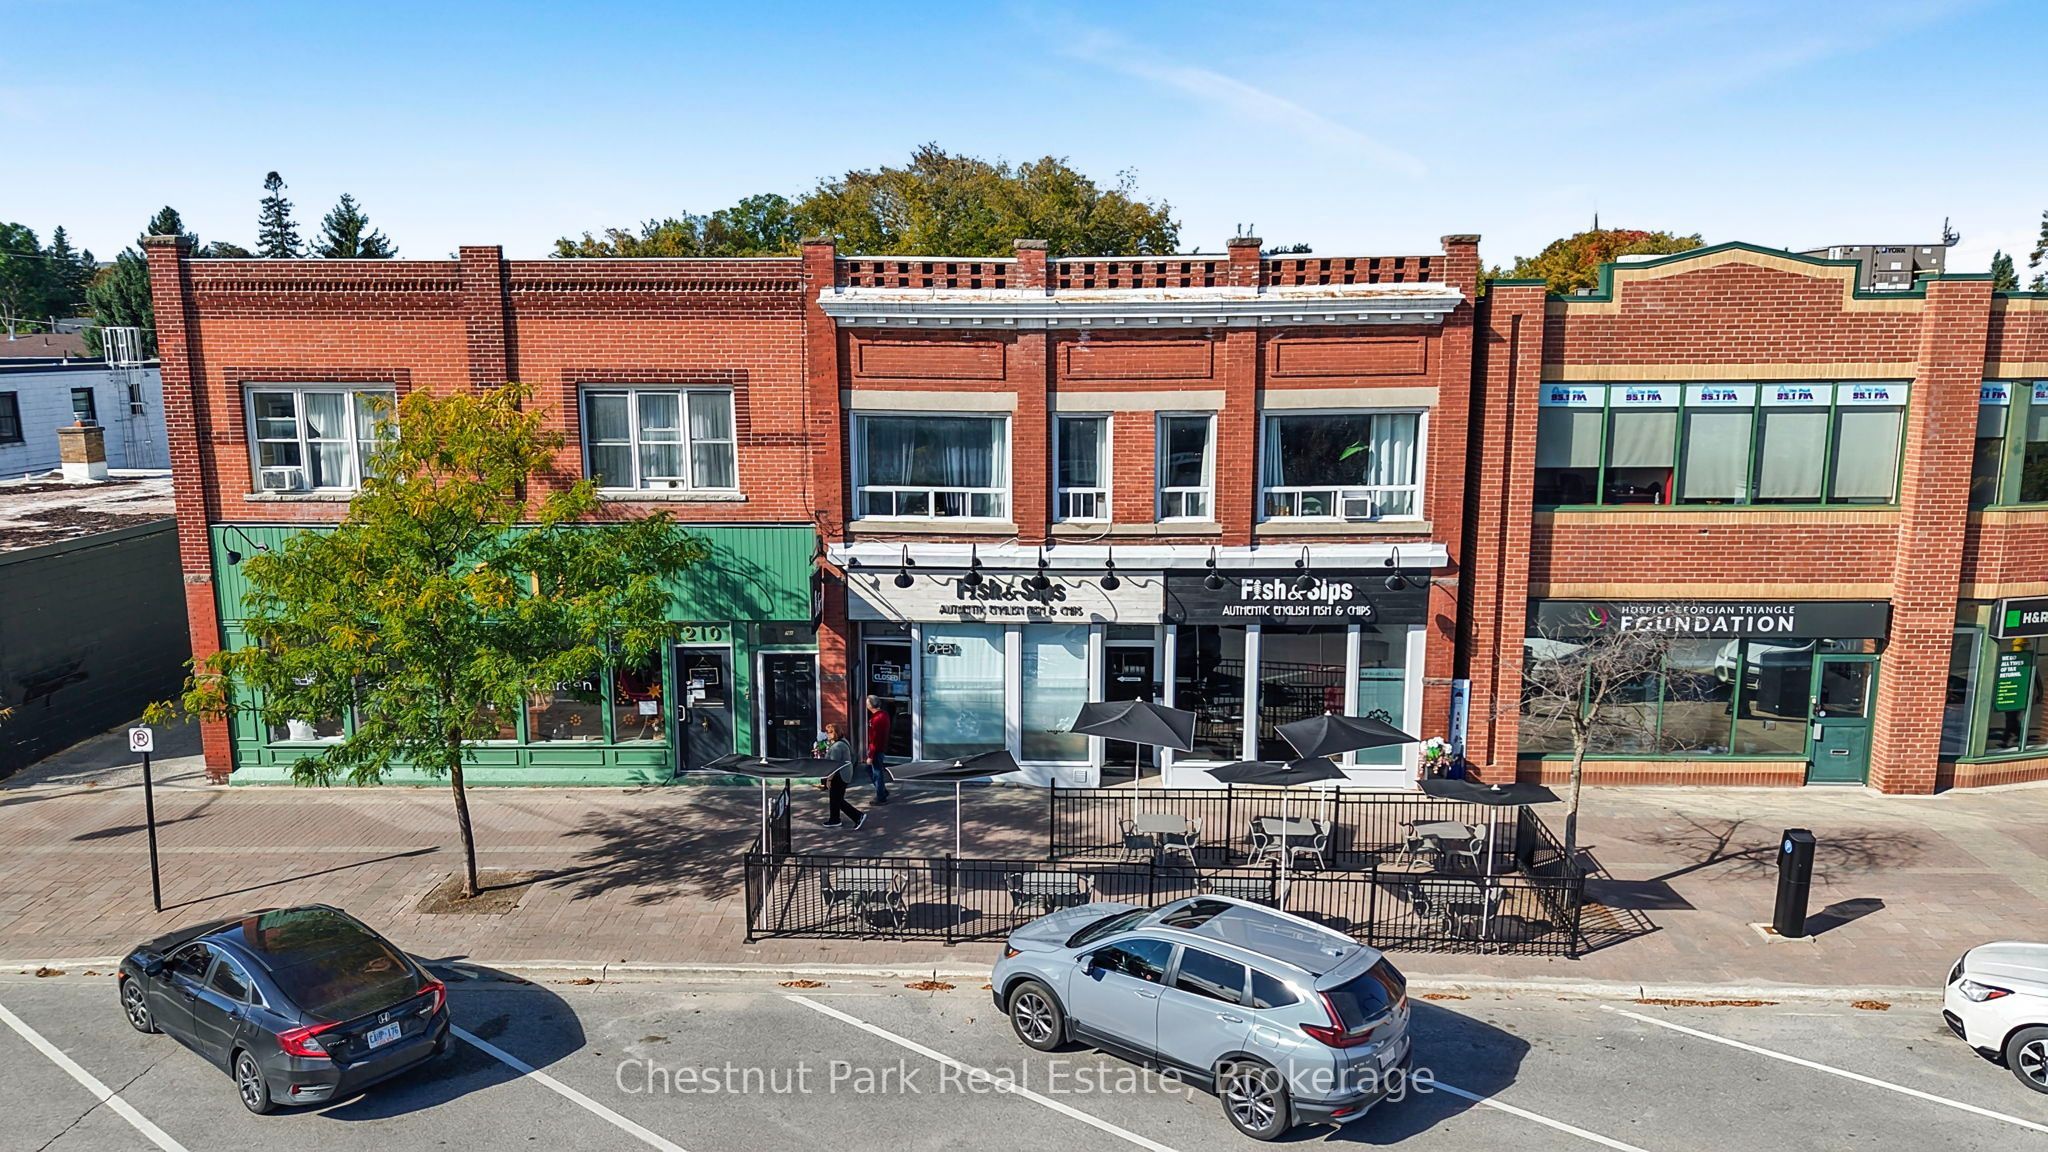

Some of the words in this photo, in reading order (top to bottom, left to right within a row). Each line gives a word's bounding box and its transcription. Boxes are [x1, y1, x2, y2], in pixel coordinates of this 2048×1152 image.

[1222, 605, 1270, 616] AUTHENTIC
[1273, 605, 1309, 616] ENGLISH
[1313, 605, 1332, 616] FISH
[1335, 605, 1344, 616] &
[1347, 605, 1371, 616] CHIPS
[1738, 606, 1796, 614] TRIANGLE
[1620, 615, 1795, 632] FOUNDATION
[928, 643, 957, 654] OPEN
[874, 673, 899, 682] CLOSED
